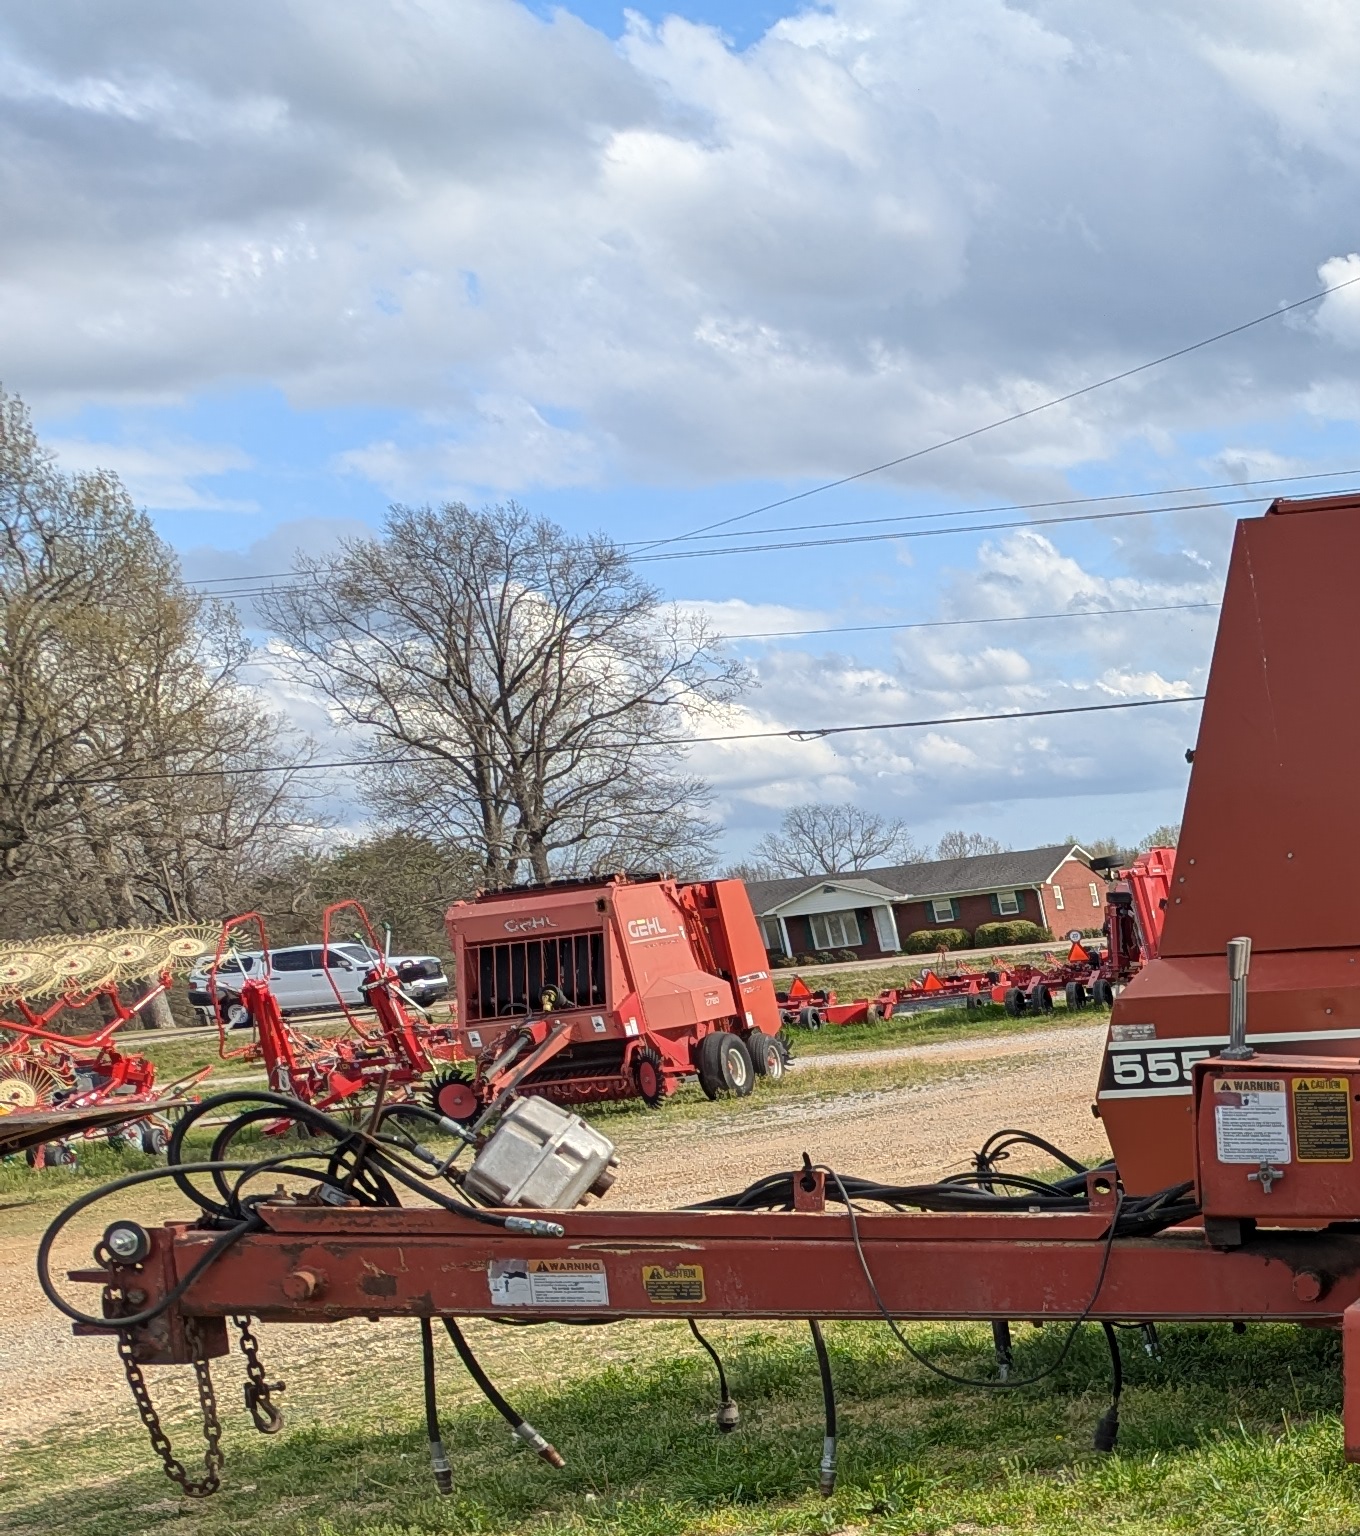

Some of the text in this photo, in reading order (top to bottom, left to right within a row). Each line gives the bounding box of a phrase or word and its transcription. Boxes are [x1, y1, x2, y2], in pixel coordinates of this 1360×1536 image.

[627, 916, 667, 938] GEHL
[1111, 1050, 1211, 1085] 555
[1233, 1080, 1280, 1092] WARNING
[1310, 1079, 1341, 1090] CAUTION
[548, 1262, 600, 1271] WARNING
